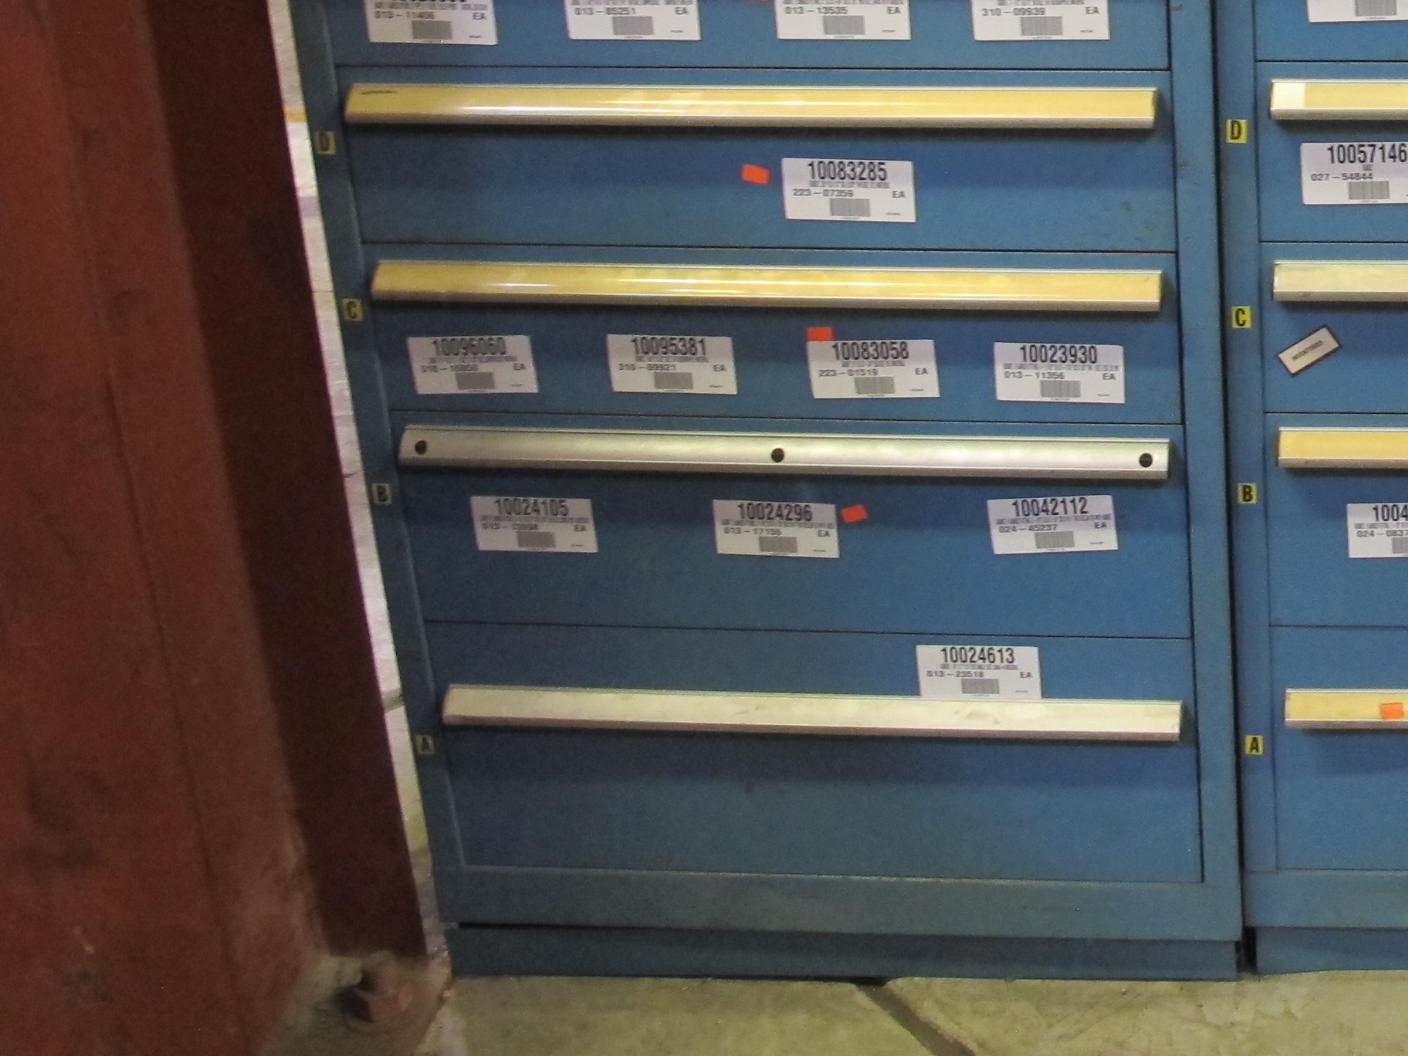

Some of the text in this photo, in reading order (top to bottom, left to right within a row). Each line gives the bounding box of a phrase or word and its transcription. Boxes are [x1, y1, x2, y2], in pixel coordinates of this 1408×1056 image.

[1230, 121, 1241, 140] D
[1327, 144, 1407, 163] 10057146
[808, 162, 887, 181] 10083285
[1236, 308, 1246, 326] C
[832, 342, 909, 360] 10083058
[1019, 345, 1097, 364] 10023930
[1243, 485, 1252, 502] B
[738, 504, 812, 521] 10024296
[1011, 498, 1088, 517] 10042112
[1094, 521, 1107, 529] EA
[941, 648, 1014, 664] 10024613
[1250, 738, 1259, 752] A
